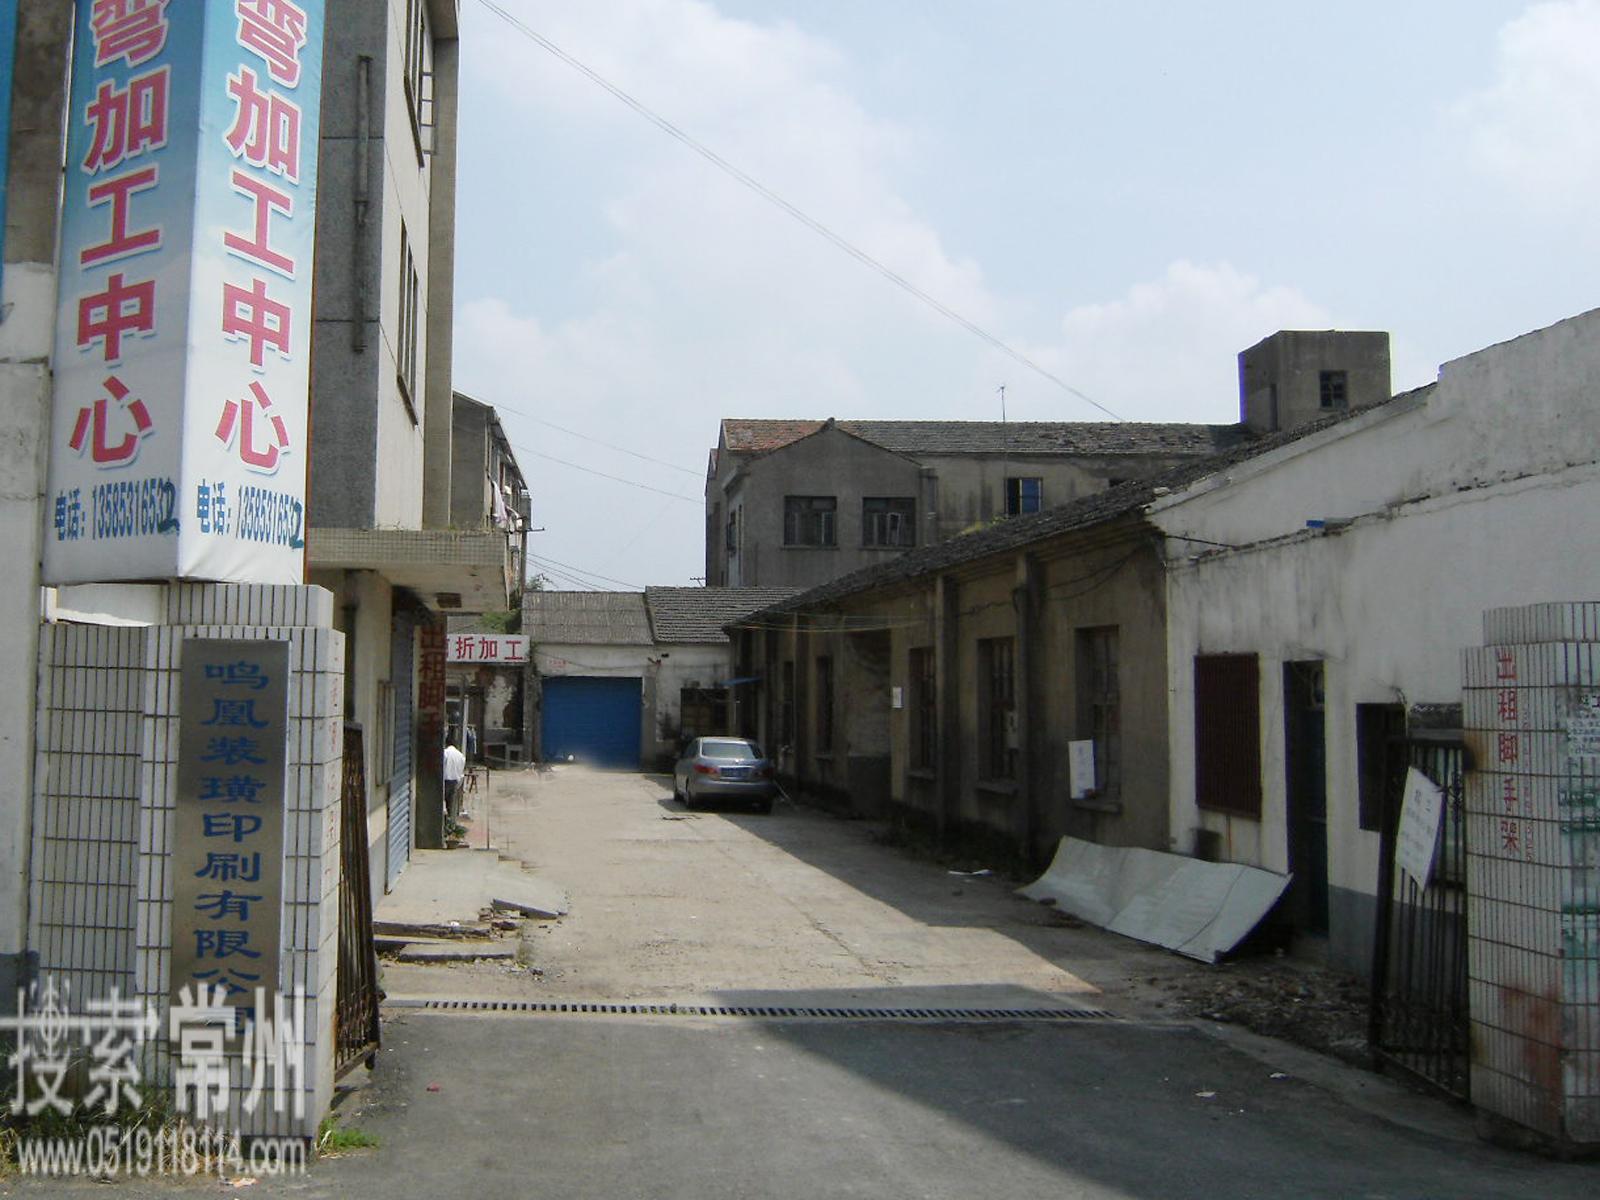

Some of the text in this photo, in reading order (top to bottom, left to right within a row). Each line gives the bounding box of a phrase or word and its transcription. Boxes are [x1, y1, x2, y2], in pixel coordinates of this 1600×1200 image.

[68, 0, 172, 470] 弯加工中心
[213, 0, 309, 475] 弯加工中心
[446, 636, 523, 661] 折加工
